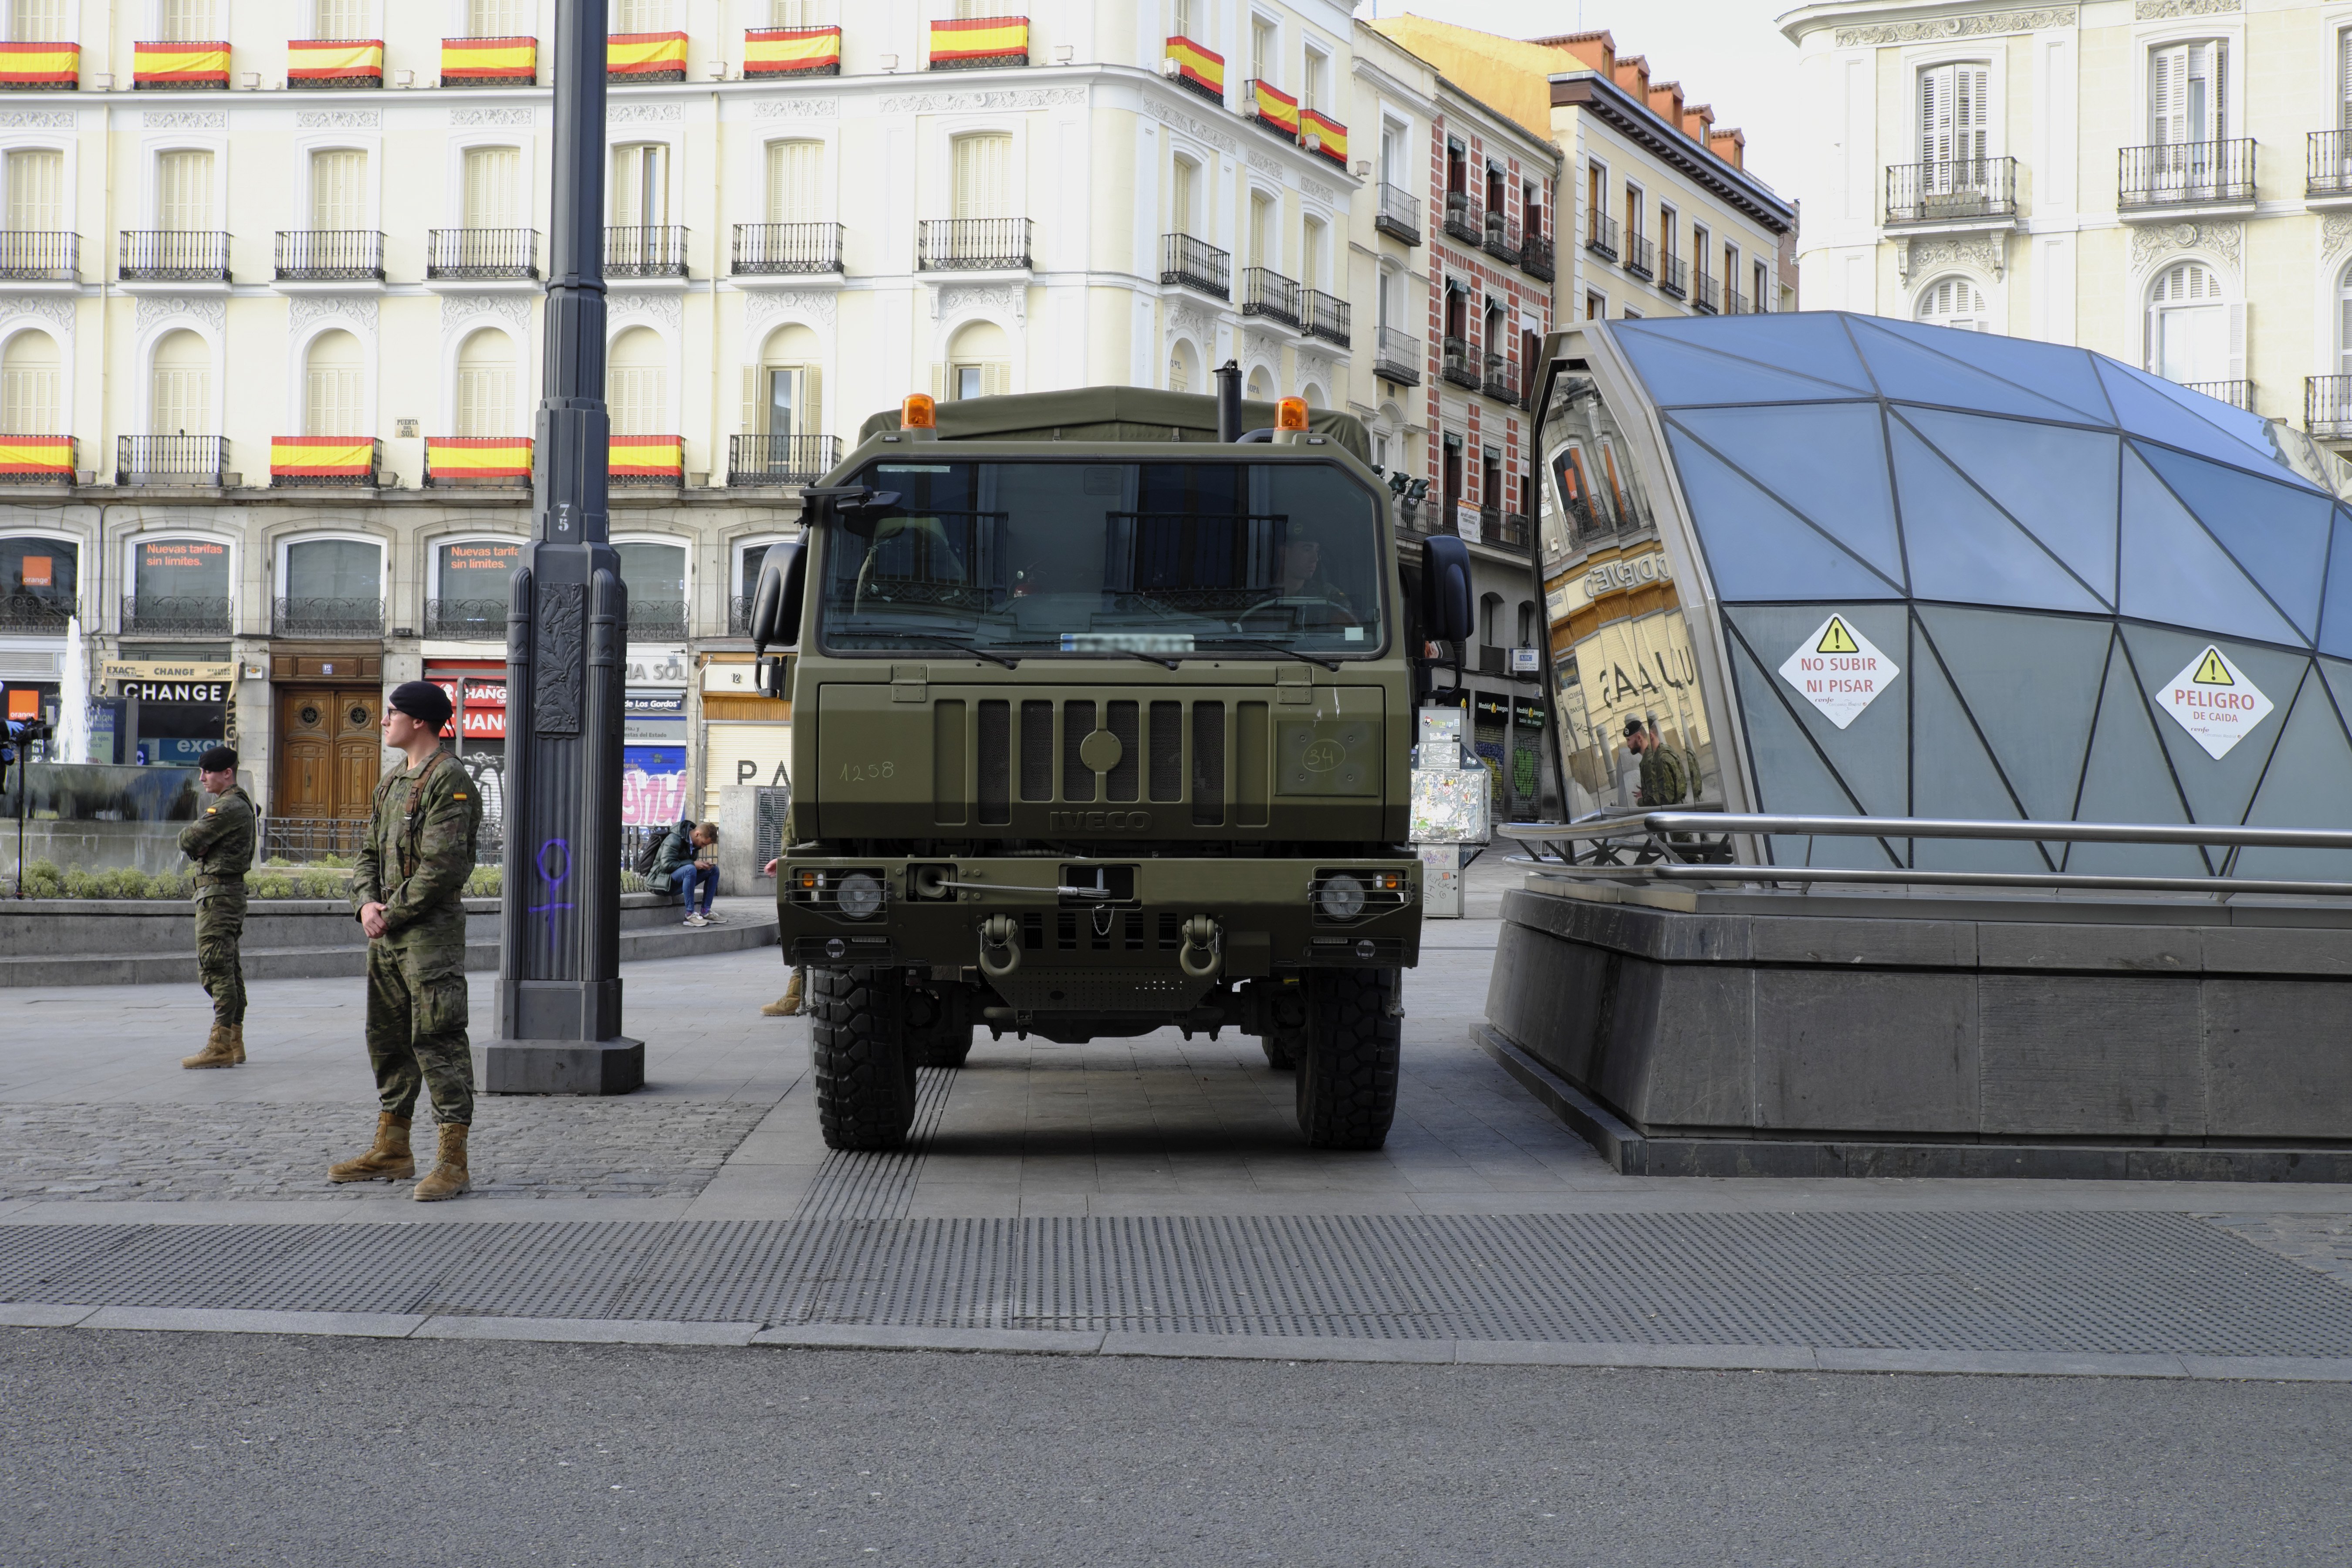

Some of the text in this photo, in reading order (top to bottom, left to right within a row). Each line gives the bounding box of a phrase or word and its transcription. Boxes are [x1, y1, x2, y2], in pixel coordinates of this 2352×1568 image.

[146, 544, 223, 554] Nuevas tarifas
[451, 546, 491, 556] Nuevas
[146, 556, 202, 566] sin límites.
[451, 559, 507, 569] sin límites.
[1801, 658, 1877, 671] NO SUBIR
[154, 667, 195, 676] CHANGE
[653, 663, 686, 680] SOL
[731, 673, 741, 683] 12
[124, 683, 222, 701] CHANGE
[1807, 679, 1874, 693] NI PISAR
[2175, 689, 2255, 710] PELIGRO
[1497, 704, 1508, 713] Juegos
[2193, 711, 2238, 723] DE CAIDA
[1308, 747, 1333, 767] 34
[839, 761, 894, 782] 1258
[1050, 811, 1153, 831] IVECO
